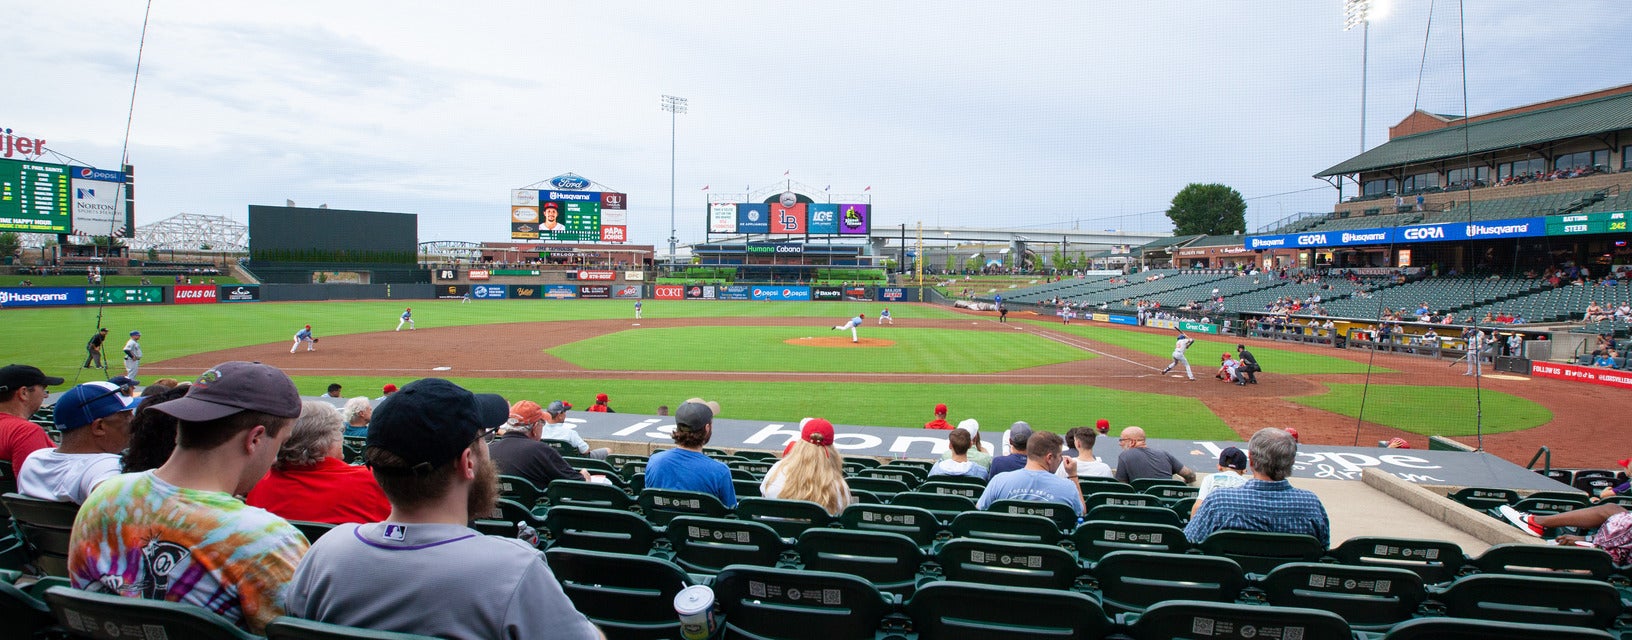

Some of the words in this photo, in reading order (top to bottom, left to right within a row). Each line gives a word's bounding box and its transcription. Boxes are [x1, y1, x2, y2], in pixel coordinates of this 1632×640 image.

[558, 178, 583, 188] Ford
[77, 202, 114, 211] NORTON
[604, 227, 623, 235] PAPA
[1476, 223, 1528, 235] Husqvarna
[1350, 232, 1386, 242] Husqvarna
[1258, 238, 1285, 246] Husqvarna
[9, 292, 67, 302] Husqvarna
[176, 290, 202, 298] LUCAS
[203, 289, 216, 297] OIL
[655, 288, 682, 297] CORT
[1186, 322, 1198, 330] Great
[1198, 324, 1209, 332] Clips
[1533, 366, 1553, 374] FOLLOW
